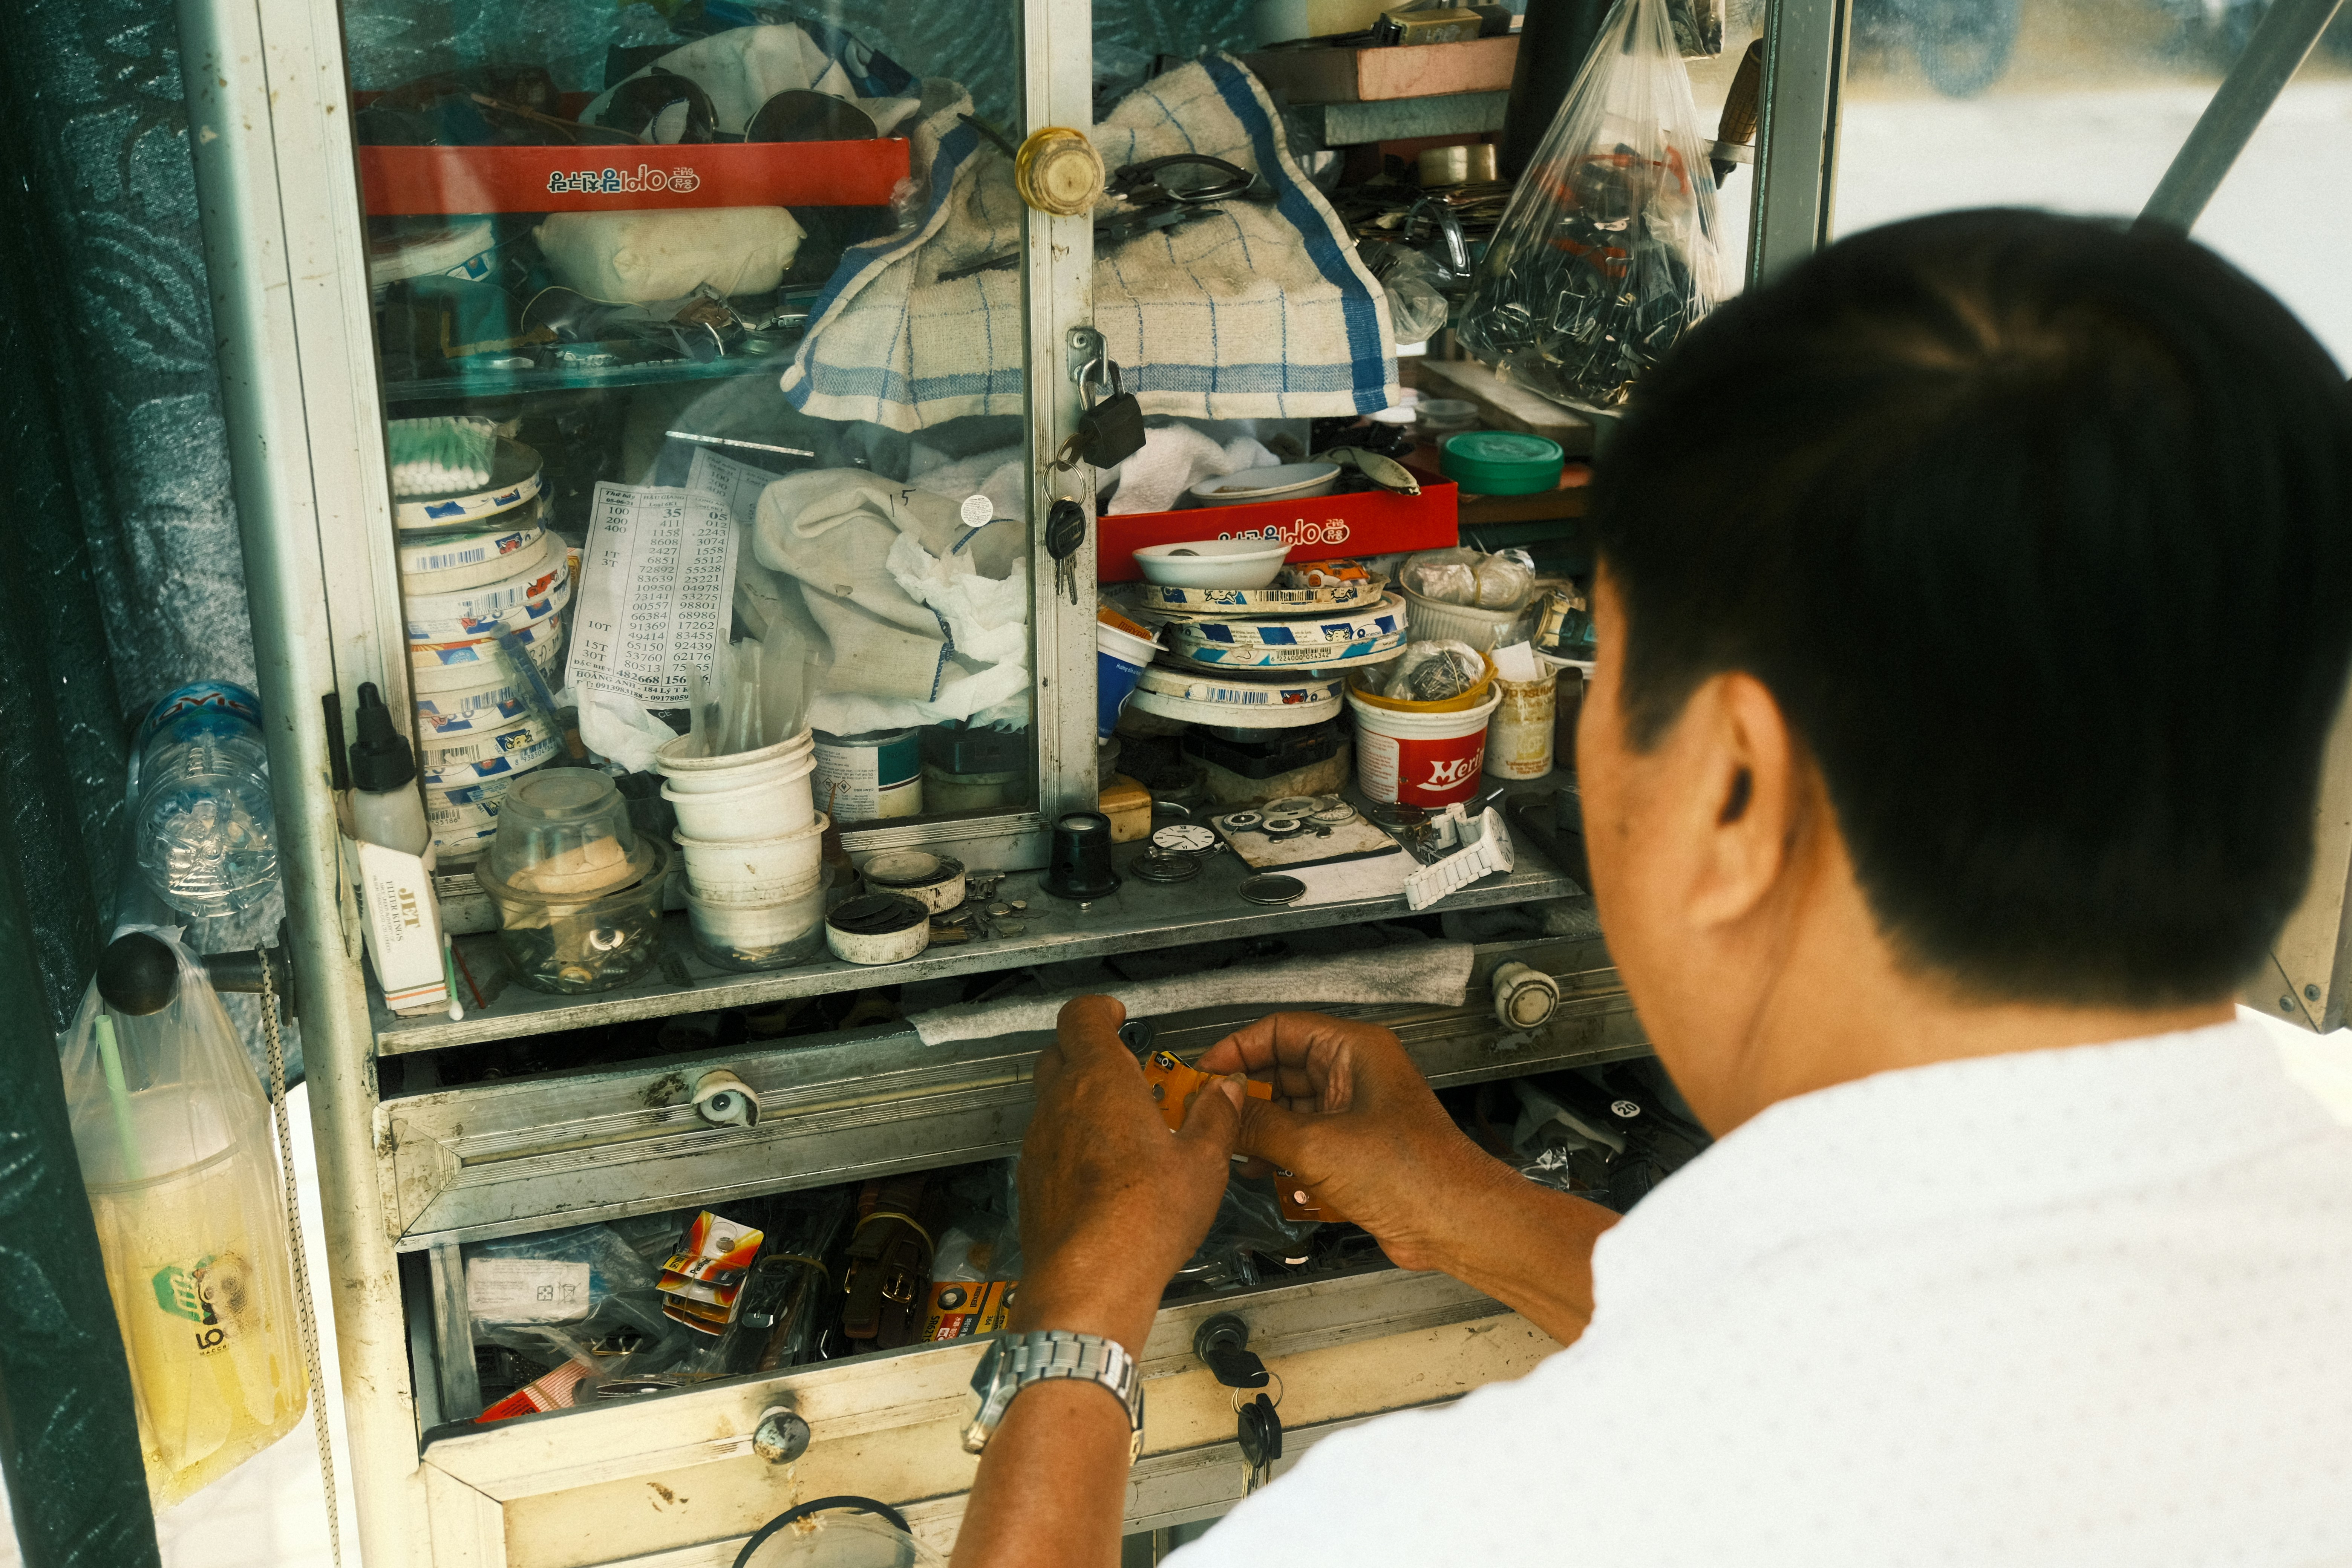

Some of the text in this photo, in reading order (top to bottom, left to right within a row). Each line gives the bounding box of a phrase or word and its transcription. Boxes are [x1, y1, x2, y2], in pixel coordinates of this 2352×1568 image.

[712, 472, 729, 482] 100
[609, 507, 629, 515] 100
[663, 509, 681, 518] 35
[709, 511, 727, 521] 05
[606, 517, 628, 525] 200
[706, 520, 727, 528] 012
[604, 525, 626, 533] 400
[697, 547, 724, 555] 1558
[601, 559, 618, 567] 3T
[694, 556, 723, 564] 5512
[685, 565, 721, 574] 55528
[632, 602, 669, 610] 00557
[631, 612, 667, 621] 66384
[588, 621, 611, 631] 10T
[630, 622, 666, 631] 91369
[628, 632, 665, 641] 49414
[585, 640, 608, 652] 15T
[627, 641, 663, 651] 65150
[675, 642, 712, 650] 92439
[582, 649, 606, 662] 30T
[626, 651, 662, 662] 53760
[624, 661, 660, 673] 80513
[672, 663, 709, 672] 7555
[576, 671, 612, 682] HOÀNG
[615, 679, 636, 689] ANH
[616, 670, 659, 684] 482668
[596, 682, 643, 698] 0913983188
[524, 750, 544, 762] 938504
[386, 880, 403, 942] FILTER KINGS
[398, 888, 421, 928] JET
[1618, 1104, 1637, 1116] 20
[970, 1286, 982, 1308] maxell
[985, 1315, 993, 1325] 364
